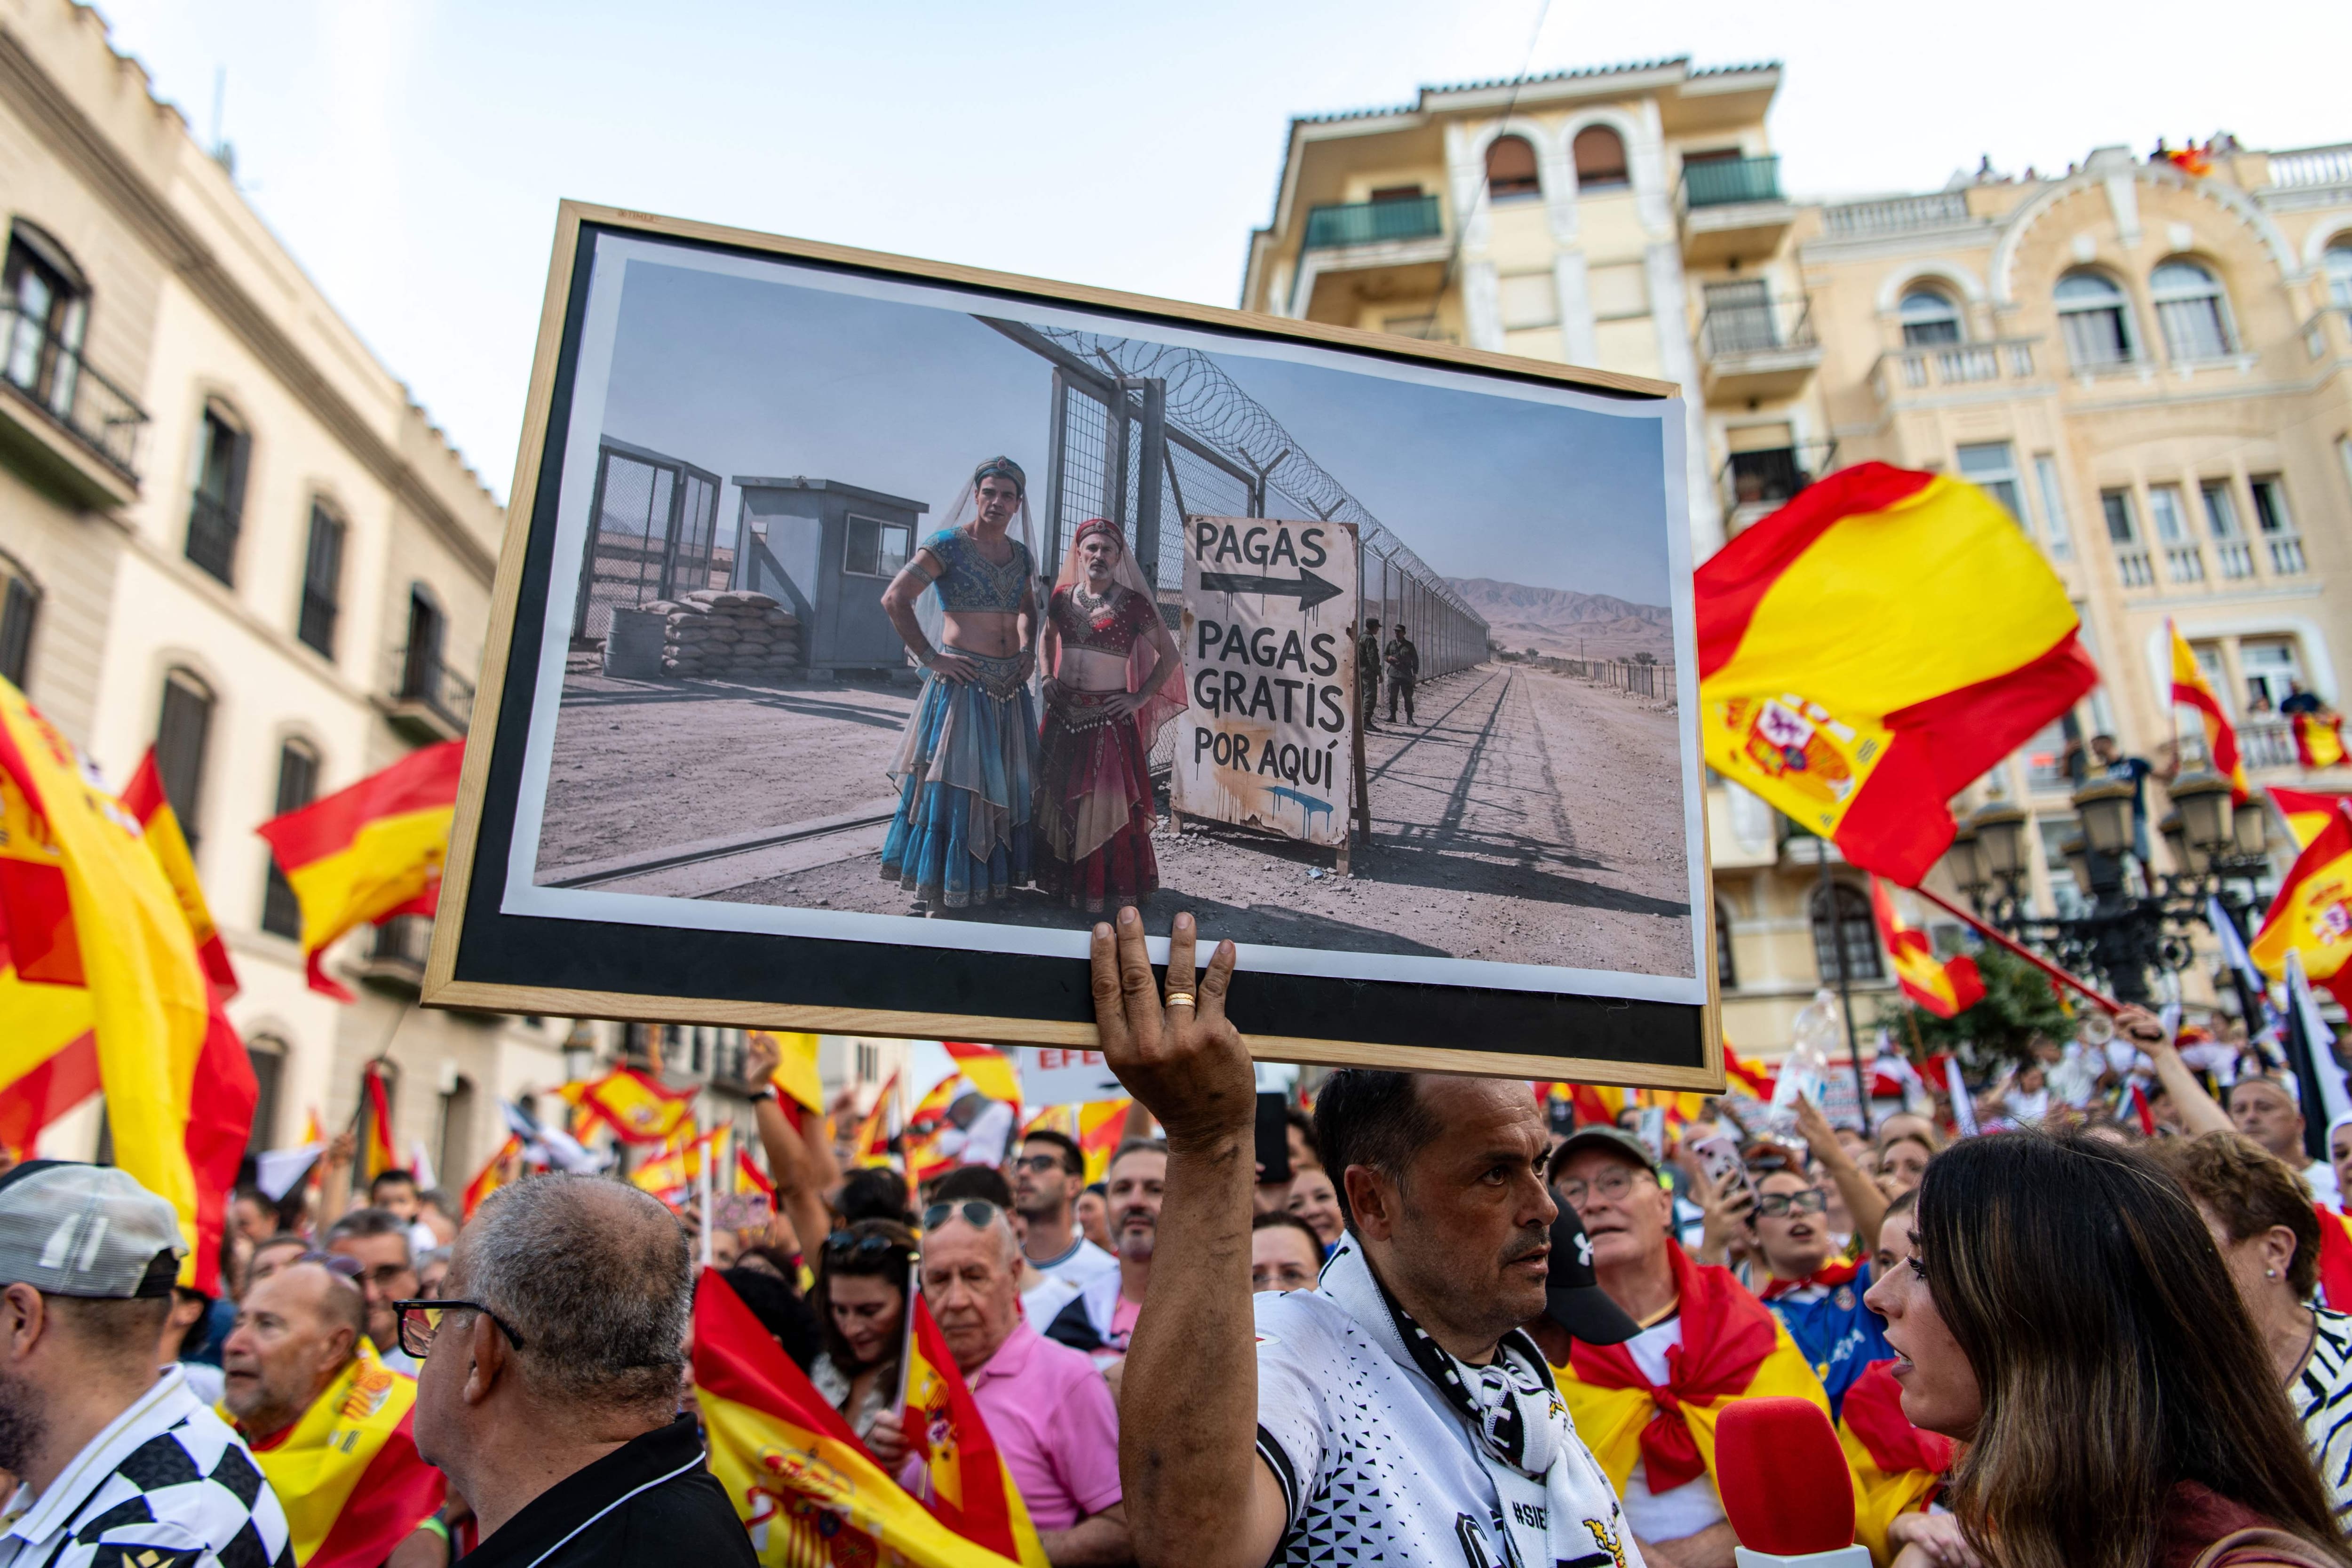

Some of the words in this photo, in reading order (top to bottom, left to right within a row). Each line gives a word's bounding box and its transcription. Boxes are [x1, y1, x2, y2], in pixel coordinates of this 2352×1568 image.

[1196, 522, 1327, 567] PAGAS
[1198, 620, 1337, 677] PAGAS
[1195, 727, 1251, 772] POR
[1257, 739, 1339, 790] AQUÍ
